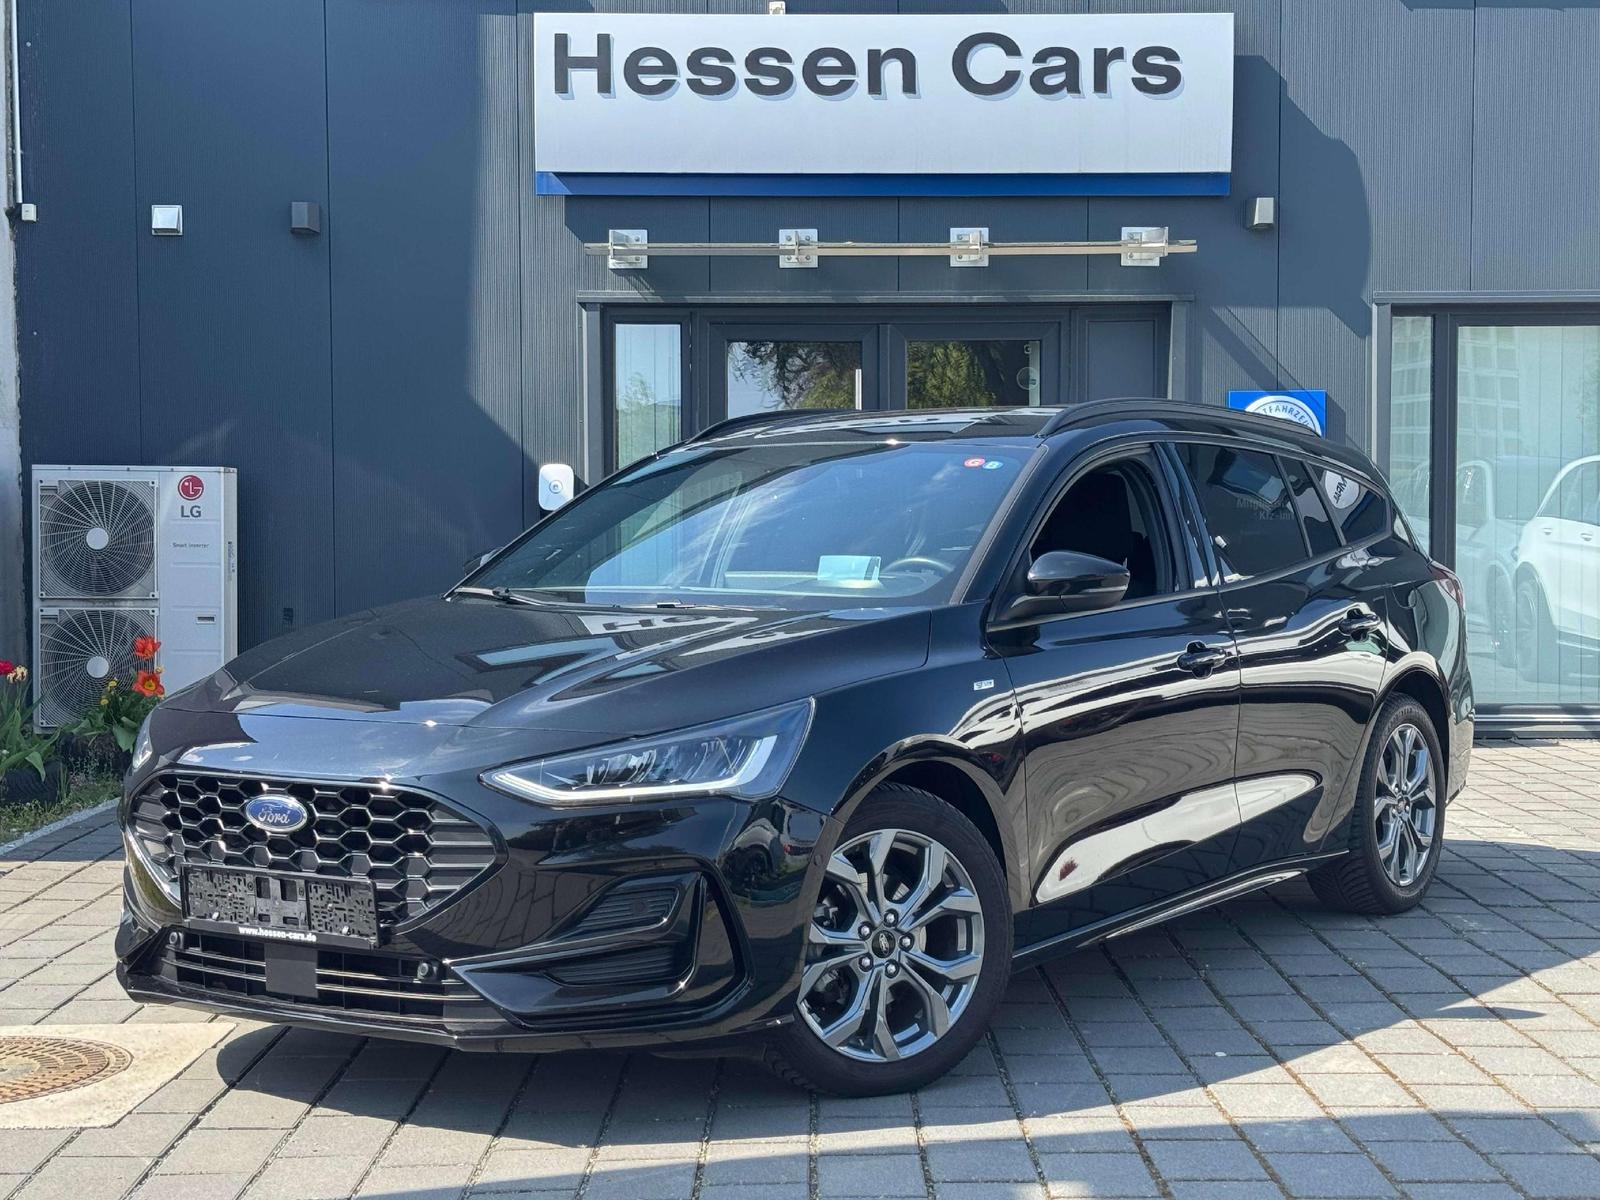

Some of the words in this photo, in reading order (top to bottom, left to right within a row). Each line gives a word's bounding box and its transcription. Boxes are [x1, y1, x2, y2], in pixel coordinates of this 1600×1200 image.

[554, 33, 917, 96] Hessen
[952, 32, 1182, 96] Cars
[181, 505, 202, 518] LG
[258, 803, 291, 823] Ford
